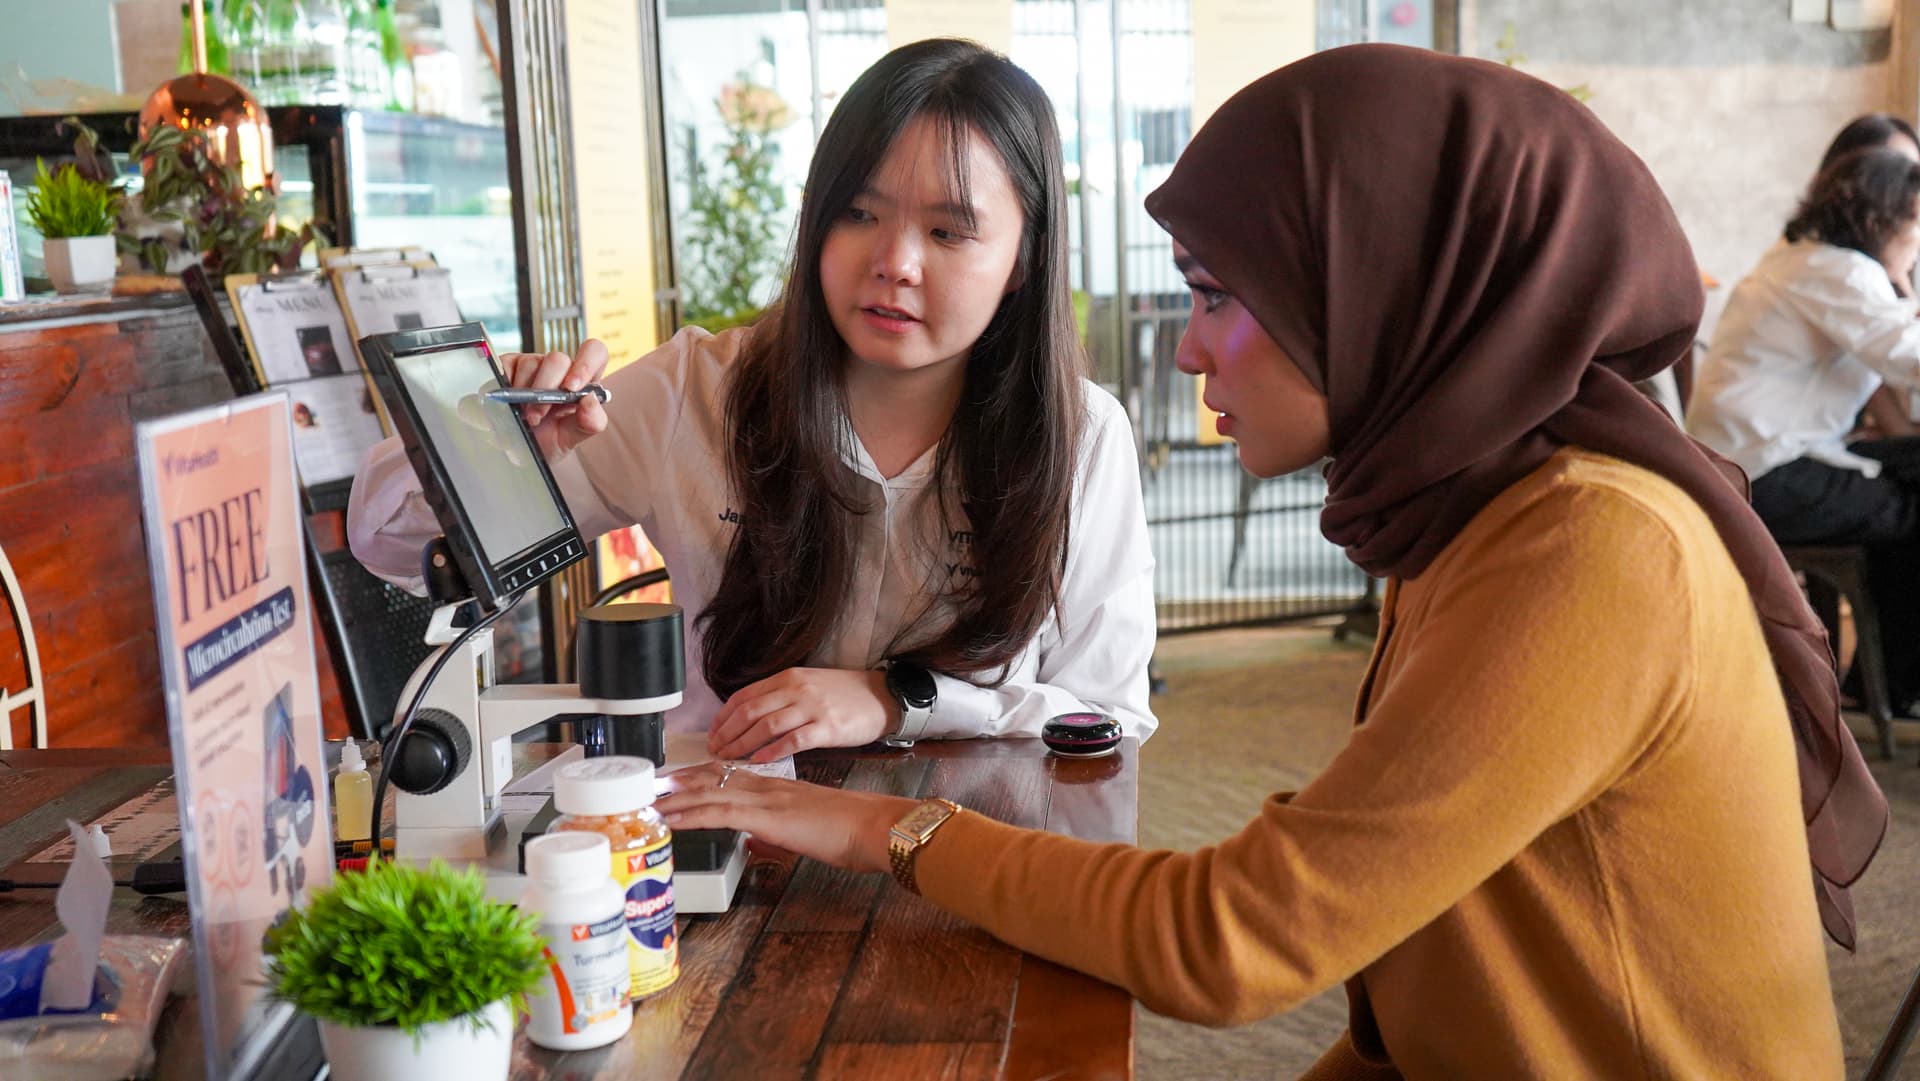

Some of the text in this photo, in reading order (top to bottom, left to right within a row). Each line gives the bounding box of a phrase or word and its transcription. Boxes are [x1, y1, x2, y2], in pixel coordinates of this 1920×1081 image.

[277, 295, 324, 313] MENU
[172, 488, 270, 623] FREE
[187, 599, 291, 678] Microcirculation Test
